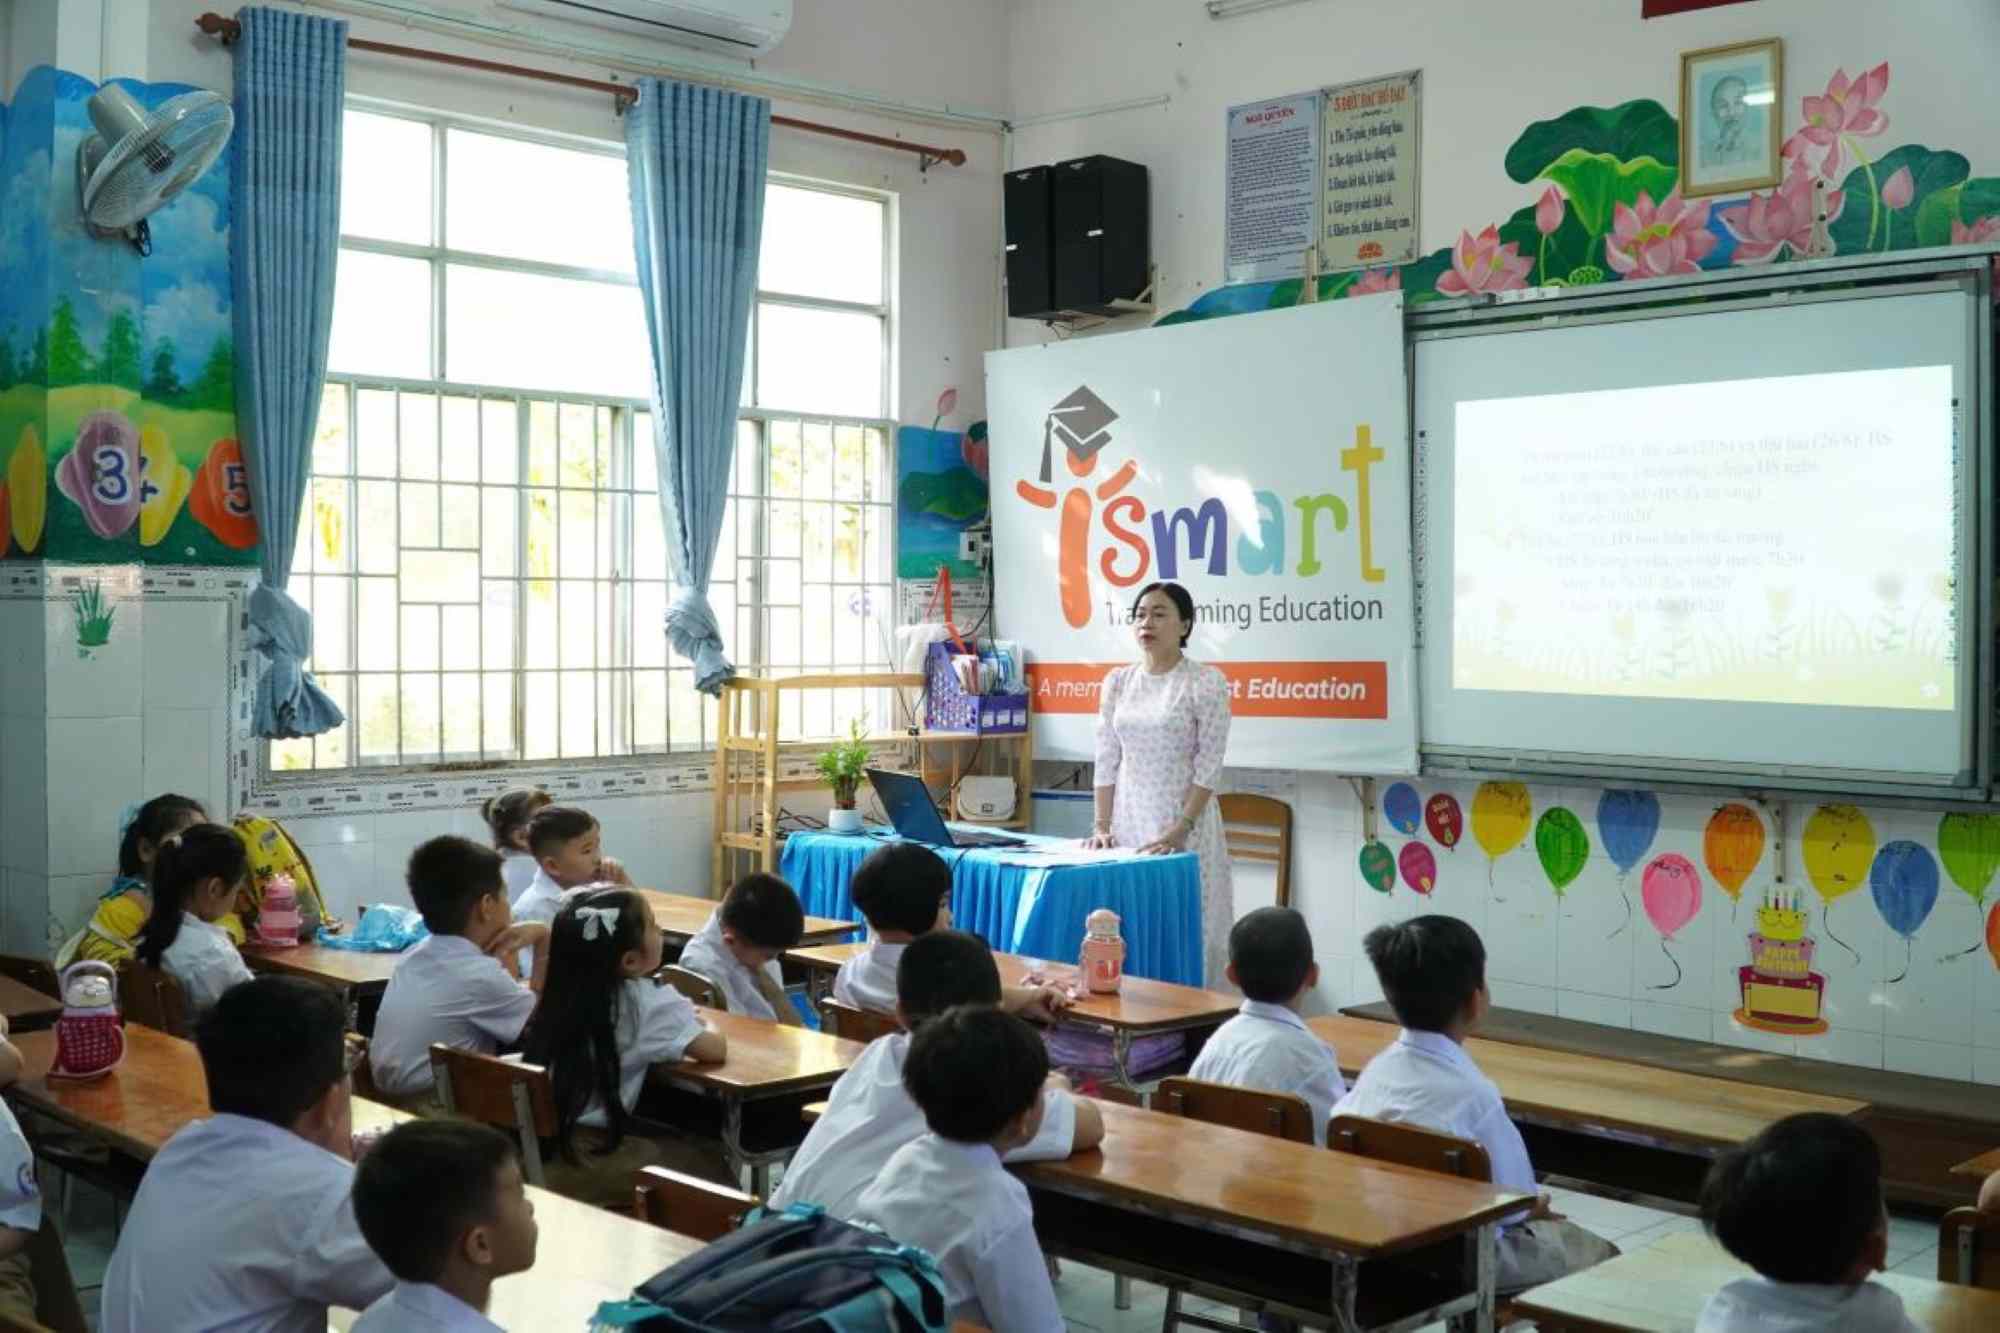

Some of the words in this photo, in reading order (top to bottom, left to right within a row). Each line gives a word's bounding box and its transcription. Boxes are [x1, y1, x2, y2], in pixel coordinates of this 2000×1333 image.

[98, 449, 127, 499] 3
[227, 465, 251, 513] 5
[1259, 594, 1383, 623] Education
[1038, 677, 1051, 697] A
[1055, 681, 1104, 697] mem
[1247, 676, 1366, 700] Education
